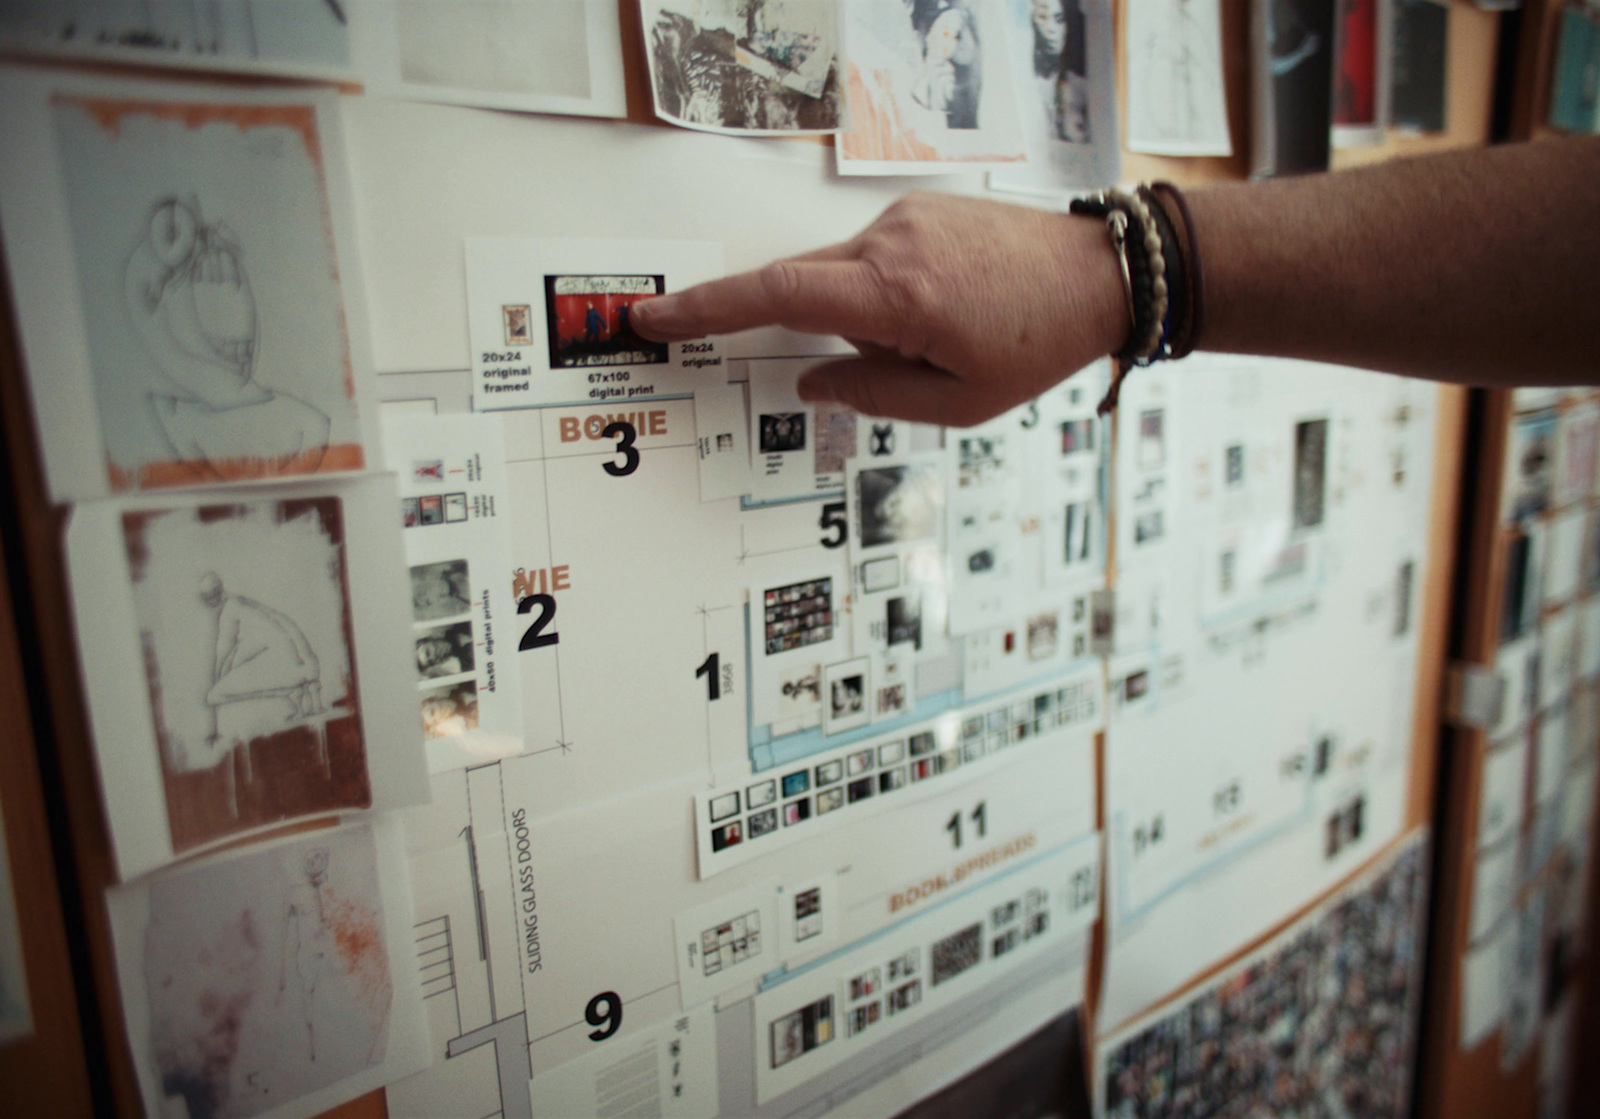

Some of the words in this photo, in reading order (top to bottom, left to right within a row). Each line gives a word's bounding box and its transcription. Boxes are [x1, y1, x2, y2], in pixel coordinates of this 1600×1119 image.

[482, 352, 522, 363] 20x24
[681, 343, 714, 353] 20x24
[682, 357, 721, 368] original
[483, 366, 532, 380] original
[484, 382, 530, 395] framed
[588, 372, 631, 384] 67x100
[589, 387, 626, 399] digital
[628, 385, 654, 398] print
[602, 421, 640, 477] 3
[820, 502, 847, 548] 5
[483, 589, 492, 619] prints
[484, 622, 494, 655] digital
[517, 593, 560, 652] 2
[487, 662, 495, 693] 40x50
[696, 652, 720, 701] 1
[512, 808, 532, 863] DOORS
[946, 801, 985, 848] 11
[520, 865, 536, 913] GLASS
[525, 915, 542, 973] SLIDING
[584, 990, 623, 1042] 9
